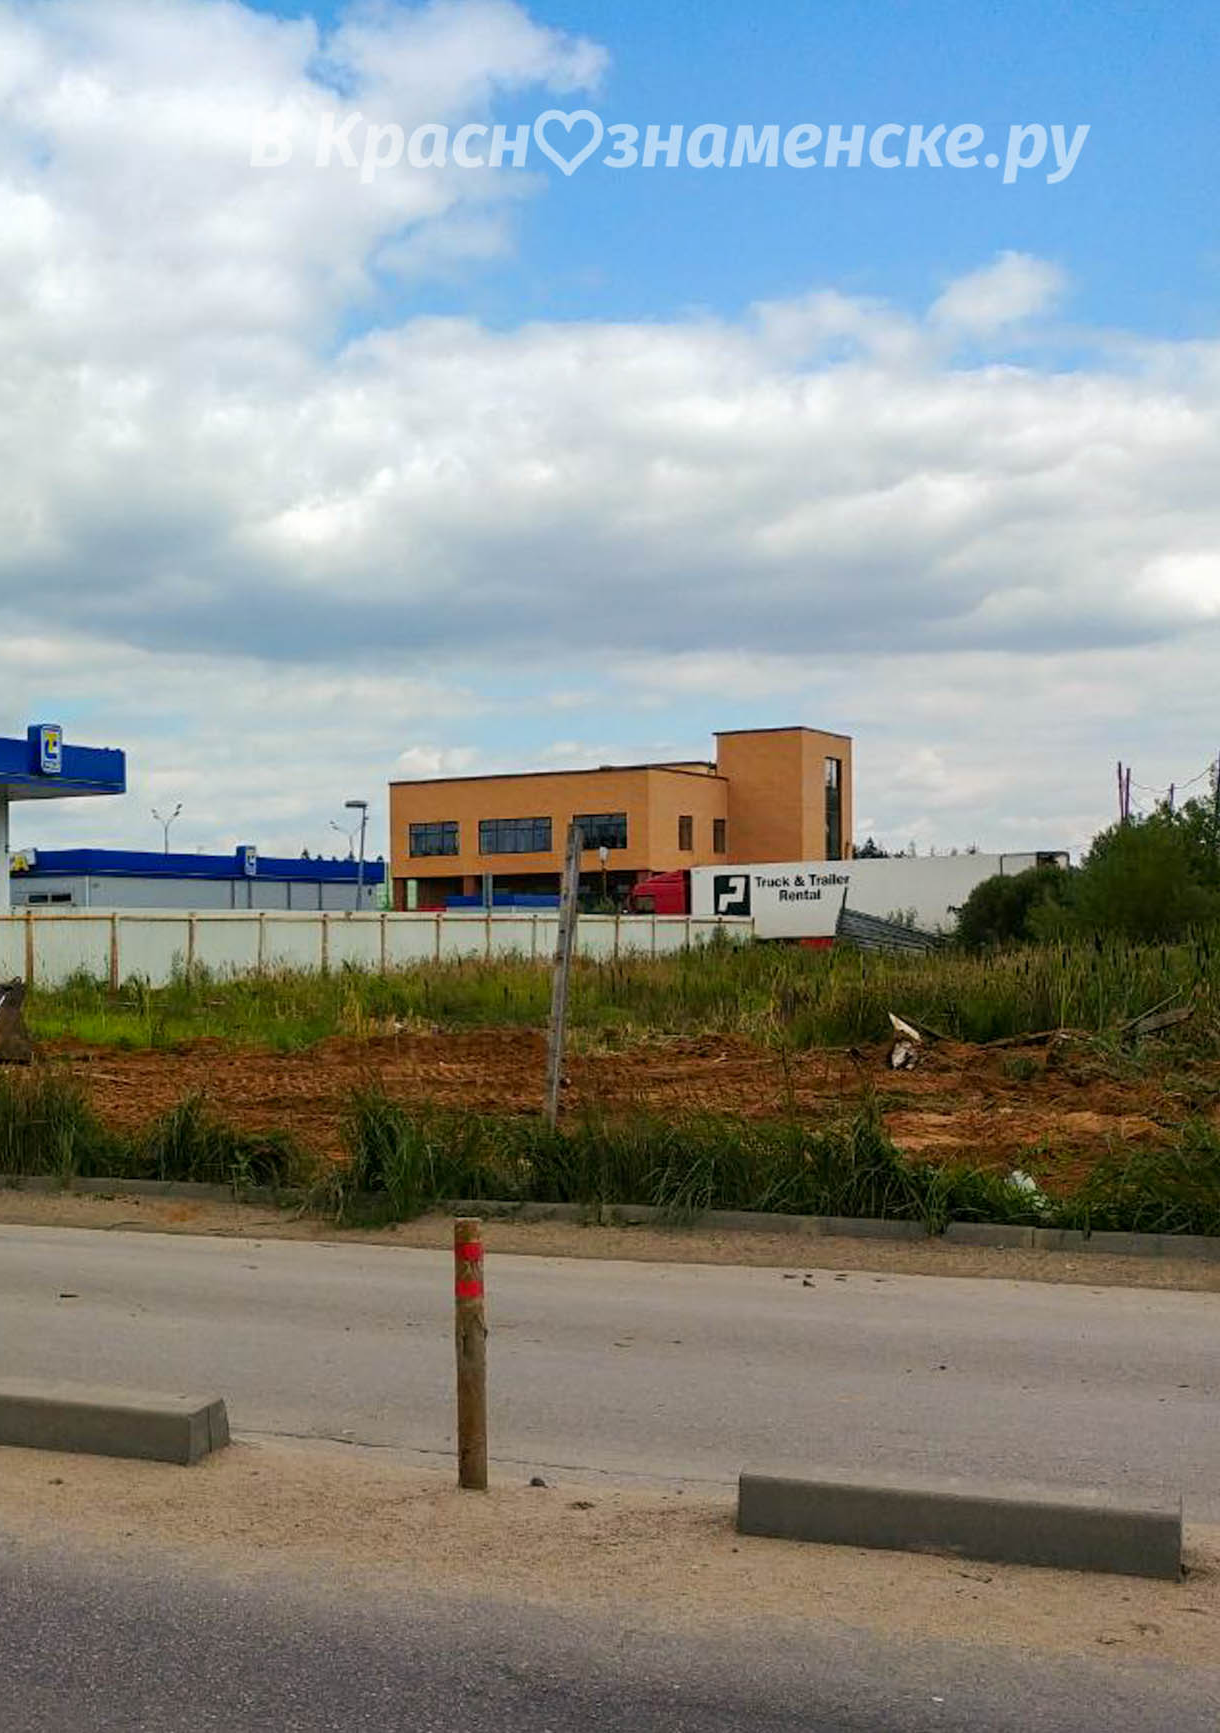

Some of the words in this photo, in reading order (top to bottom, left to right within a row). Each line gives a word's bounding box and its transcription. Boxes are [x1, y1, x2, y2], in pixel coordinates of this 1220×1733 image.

[755, 876, 790, 888] Truck
[794, 875, 805, 887] &
[808, 874, 850, 886] Trailer
[779, 889, 822, 901] Rental
